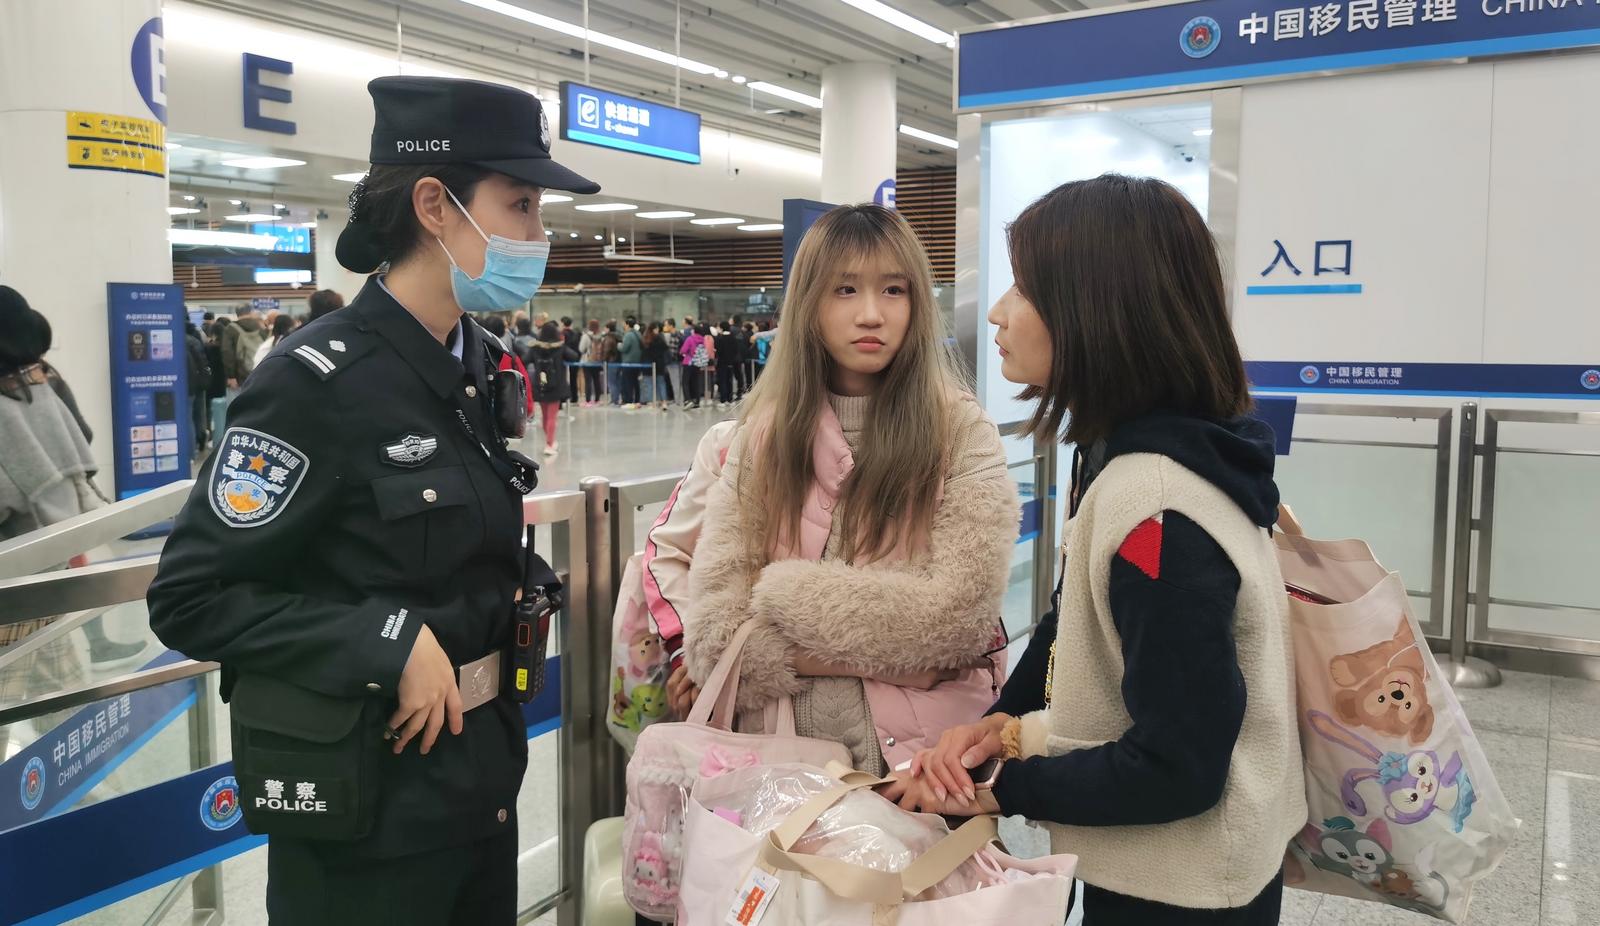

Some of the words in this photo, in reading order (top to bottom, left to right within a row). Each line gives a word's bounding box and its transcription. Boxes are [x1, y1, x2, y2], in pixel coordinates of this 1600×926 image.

[1239, 0, 1458, 45] 中国移民管理
[242, 52, 297, 135] E
[396, 139, 451, 153] POLICE
[1260, 239, 1352, 277] 入口
[1326, 365, 1403, 378] 中国移民管理
[231, 434, 301, 470] 中华人民共和国
[380, 614, 397, 638] CHINA
[53, 692, 131, 767] 中国移民管理
[58, 760, 82, 786] CHINA
[85, 722, 129, 766] IMMIGRATION
[255, 796, 328, 812] POLICE
